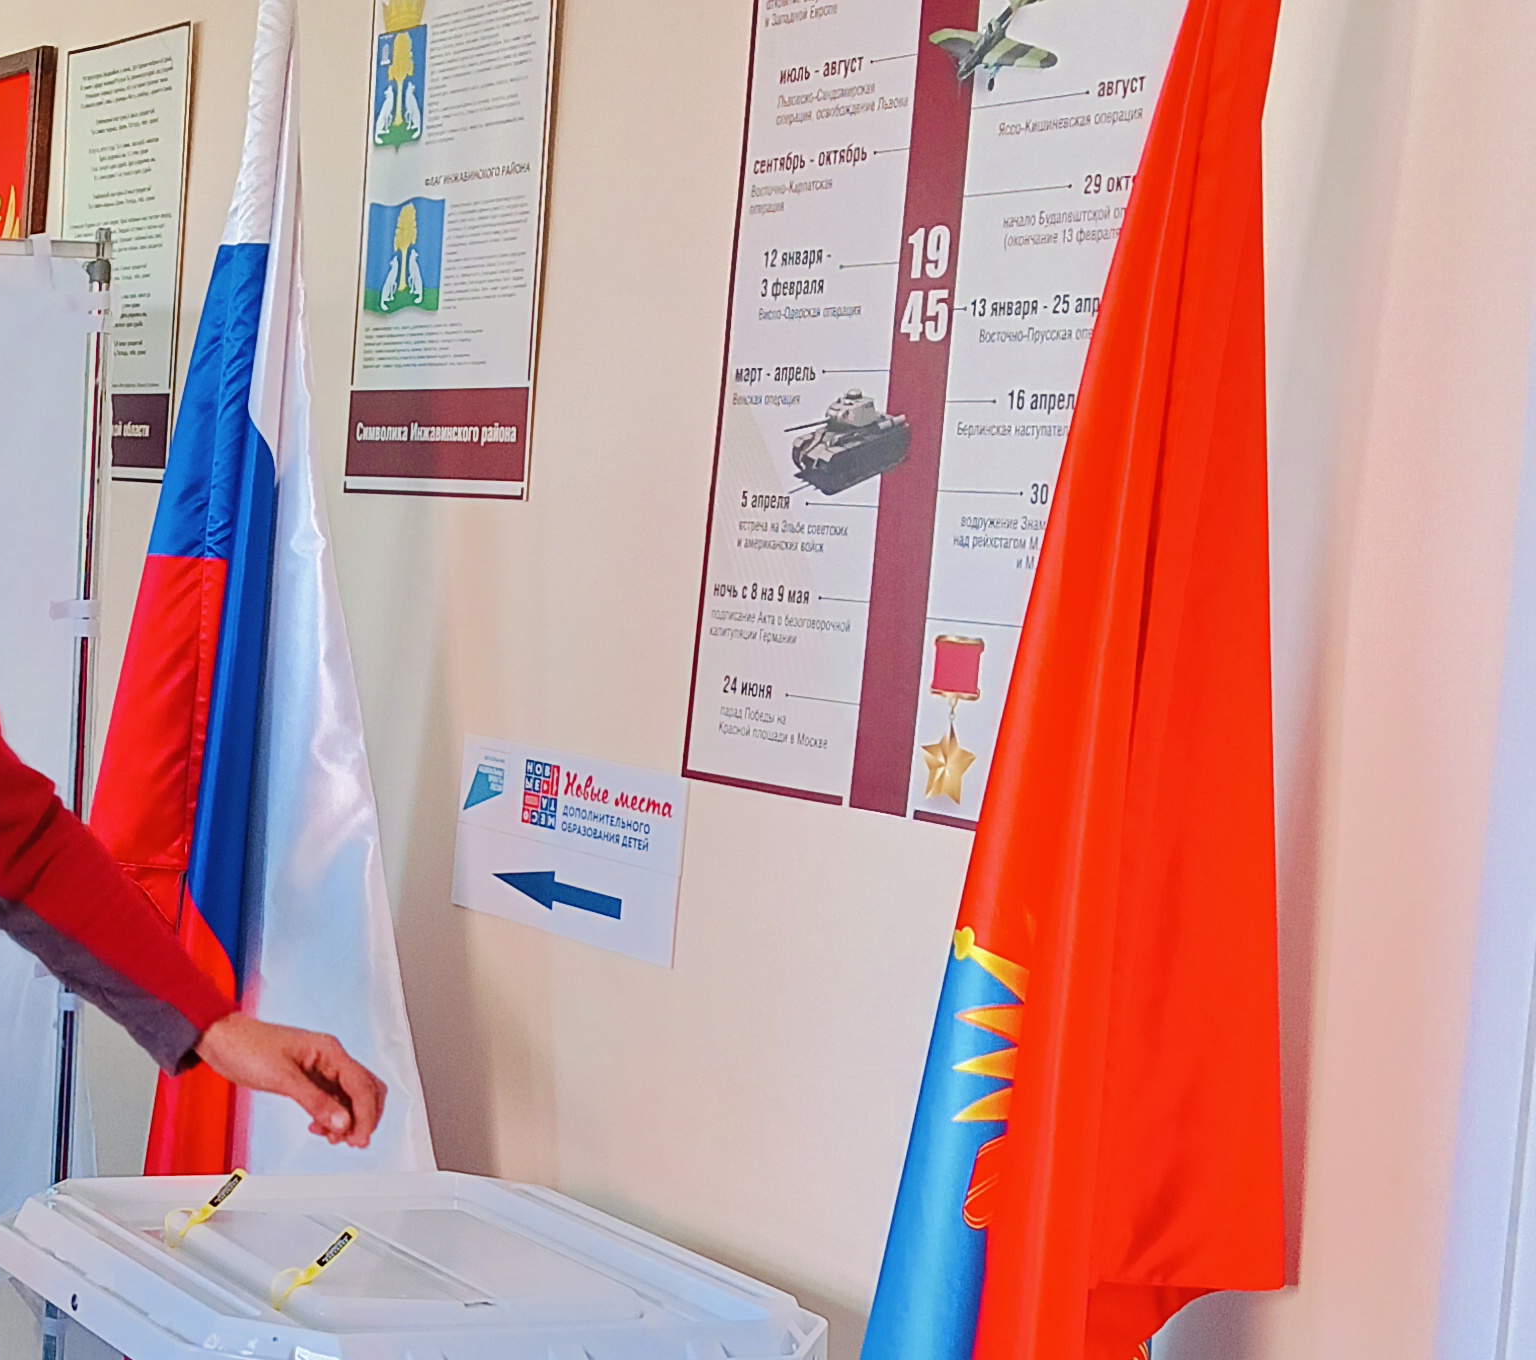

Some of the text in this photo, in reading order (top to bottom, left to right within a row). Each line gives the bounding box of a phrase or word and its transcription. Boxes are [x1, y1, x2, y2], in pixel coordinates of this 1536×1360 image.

[779, 65, 810, 85] июль
[823, 56, 864, 79] август
[1097, 75, 1146, 98] август
[998, 107, 1143, 136] Яссо-Кишиневская операция
[753, 151, 805, 175] сентябрь
[818, 143, 867, 167] октябрь
[1084, 174, 1101, 194] 29
[1003, 214, 1035, 228] начало
[1039, 206, 1110, 228] Будапештской
[1062, 228, 1073, 243] 13
[764, 249, 778, 268] 12
[781, 248, 823, 270] января
[908, 225, 951, 279] 19
[761, 278, 825, 301] 3 февраля
[900, 289, 949, 342] 45
[971, 298, 986, 317] 13
[990, 298, 1038, 319] января
[1052, 294, 1070, 314] 25
[979, 327, 1072, 344] Восточно-Прусская
[735, 366, 762, 385] март
[774, 365, 815, 386] апрель
[1008, 389, 1075, 415] 16 апрел
[356, 422, 516, 447] Символика Инжавинского района
[957, 422, 1012, 438] Берлинская
[741, 491, 790, 512] 5 апреля
[1030, 483, 1049, 505] 30
[770, 522, 779, 533] на
[953, 535, 970, 549] над
[972, 534, 1027, 550] рейхстагом
[1016, 558, 1022, 569] и
[714, 582, 810, 605] ночь с 8 на 9 мая
[711, 609, 851, 633] подписание Акта о безоговорочной
[759, 628, 797, 644] Германии
[723, 675, 772, 699] 24 июня
[720, 706, 786, 725] парад Победы на
[719, 721, 751, 738] Красной
[797, 732, 828, 749] Москве
[564, 771, 673, 818] Новые места
[562, 805, 651, 835] ДОПОЛНИТЕЛЬНОГО
[561, 823, 649, 852] ОБРАЗОВАНИЯ ДЕТЕЙ
